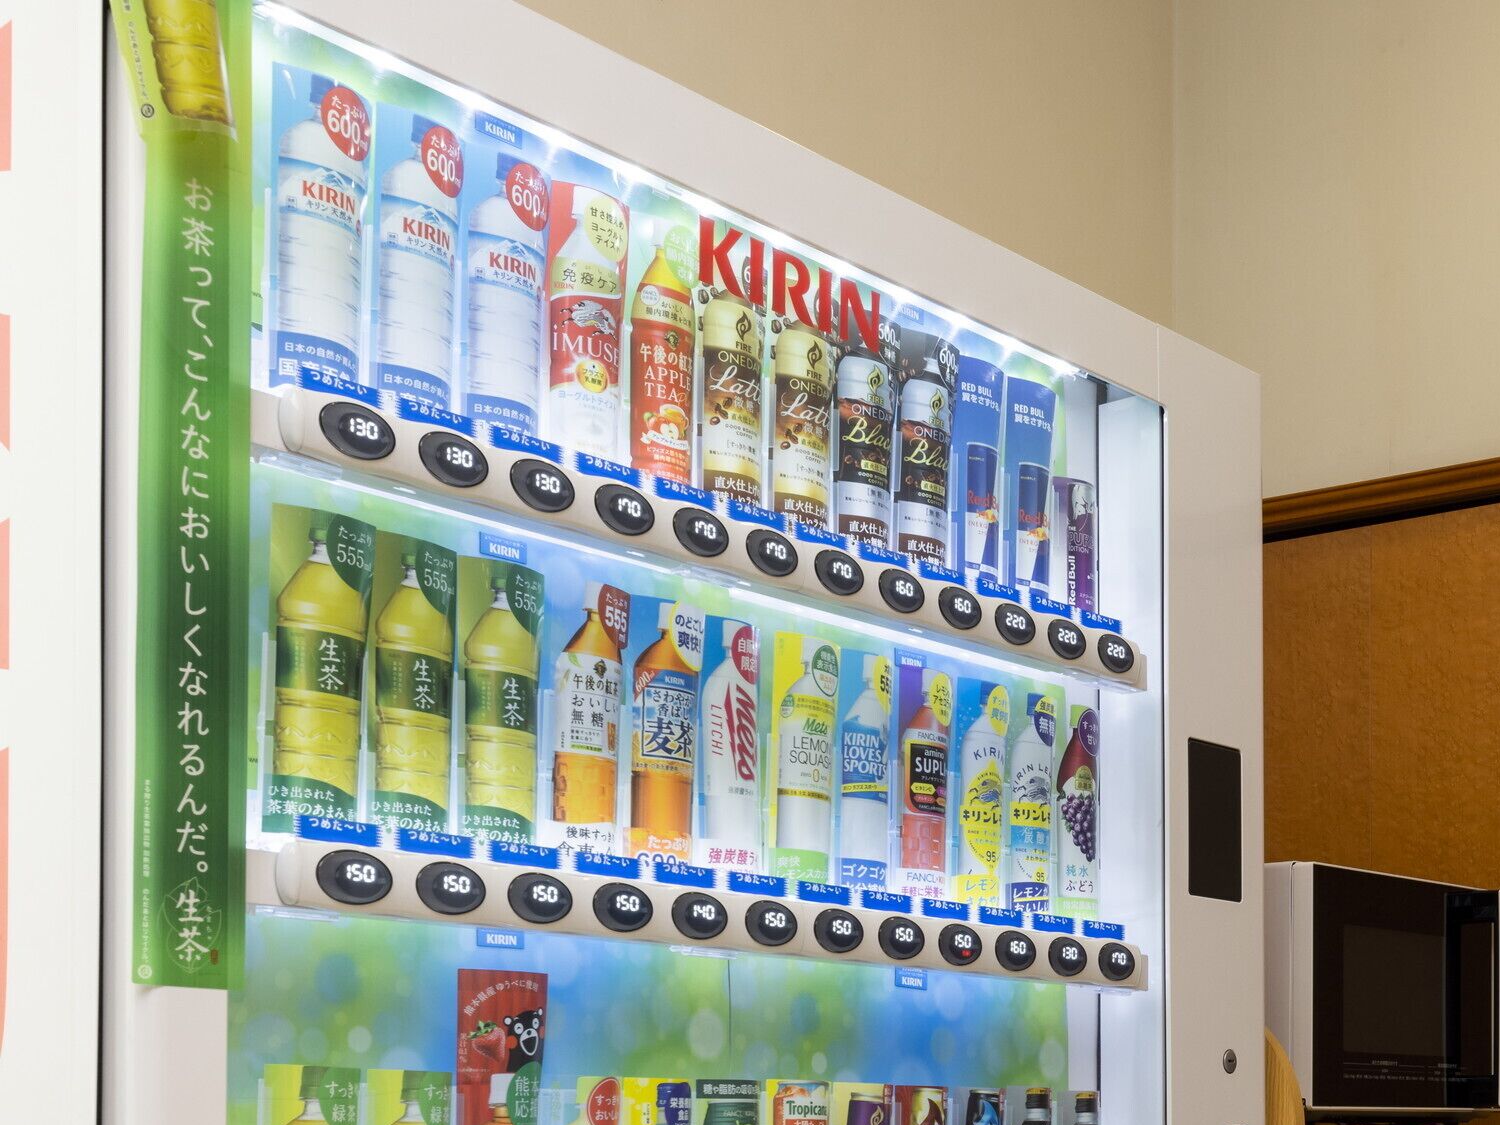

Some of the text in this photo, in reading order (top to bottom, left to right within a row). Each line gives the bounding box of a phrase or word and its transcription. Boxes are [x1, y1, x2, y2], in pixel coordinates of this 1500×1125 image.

[484, 121, 516, 143] KIRIN
[302, 180, 356, 215] KIRIN
[402, 218, 451, 251] KIRIN
[489, 252, 537, 284] KIRIN
[563, 266, 618, 295] 免疫ケア
[699, 215, 881, 353] KIRIN
[735, 341, 753, 353] FIRE
[806, 371, 823, 382] FIRE
[644, 382, 677, 402] TEA
[961, 382, 993, 398] RED BULL
[866, 394, 884, 406] FIRE
[1014, 403, 1045, 419] RED BULL
[350, 417, 379, 440] 130
[928, 416, 945, 428] FIRE
[447, 446, 474, 468] 130
[535, 473, 561, 494] 130
[618, 497, 642, 518] 170
[174, 178, 215, 874] お茶って、こんなにおいしくなれるんだ。
[695, 520, 717, 540] 170
[338, 525, 373, 546] たっぷり
[488, 543, 520, 560] KIRIN
[766, 541, 787, 560] 170
[424, 551, 454, 572] たっぷり
[833, 560, 853, 580] 170
[895, 580, 914, 597] 160
[954, 597, 972, 614] 160
[675, 614, 704, 634] のどごし
[1005, 612, 1027, 630] 220
[1057, 627, 1077, 645] 220
[1106, 642, 1126, 659] 220
[317, 637, 344, 691] 生茶
[901, 656, 922, 668] KIRIN
[412, 658, 436, 709] 生茶
[664, 677, 685, 686] KIRIN
[502, 677, 525, 726] 生茶
[571, 708, 605, 729] 無糖
[803, 717, 829, 735] Mets
[645, 717, 694, 758] 麦茶
[710, 703, 723, 757] LITCHI
[844, 732, 880, 747] KIRIN
[843, 745, 882, 762] LOVES
[924, 749, 944, 759] amino
[843, 759, 888, 778] SPORTS
[268, 785, 335, 802] ひき出された
[372, 801, 432, 816] ひき出された
[462, 815, 520, 829] ひき出された
[346, 863, 376, 883] 150
[842, 864, 886, 880] ゴクゴク
[906, 872, 936, 883] FANCL
[443, 874, 470, 893] 150
[1066, 880, 1094, 894] ぶどう
[533, 885, 559, 903] 150
[616, 894, 640, 912] 150
[693, 904, 716, 920] 140
[765, 911, 786, 928] 150
[174, 889, 210, 961] 生茶
[832, 920, 852, 936] 150
[487, 933, 518, 947] KIRIN
[896, 927, 914, 942] 150
[955, 934, 972, 948] 150
[1010, 940, 1026, 954] 160
[1063, 946, 1078, 959] 130
[1111, 952, 1126, 964] 170
[901, 976, 923, 988] KIRIN
